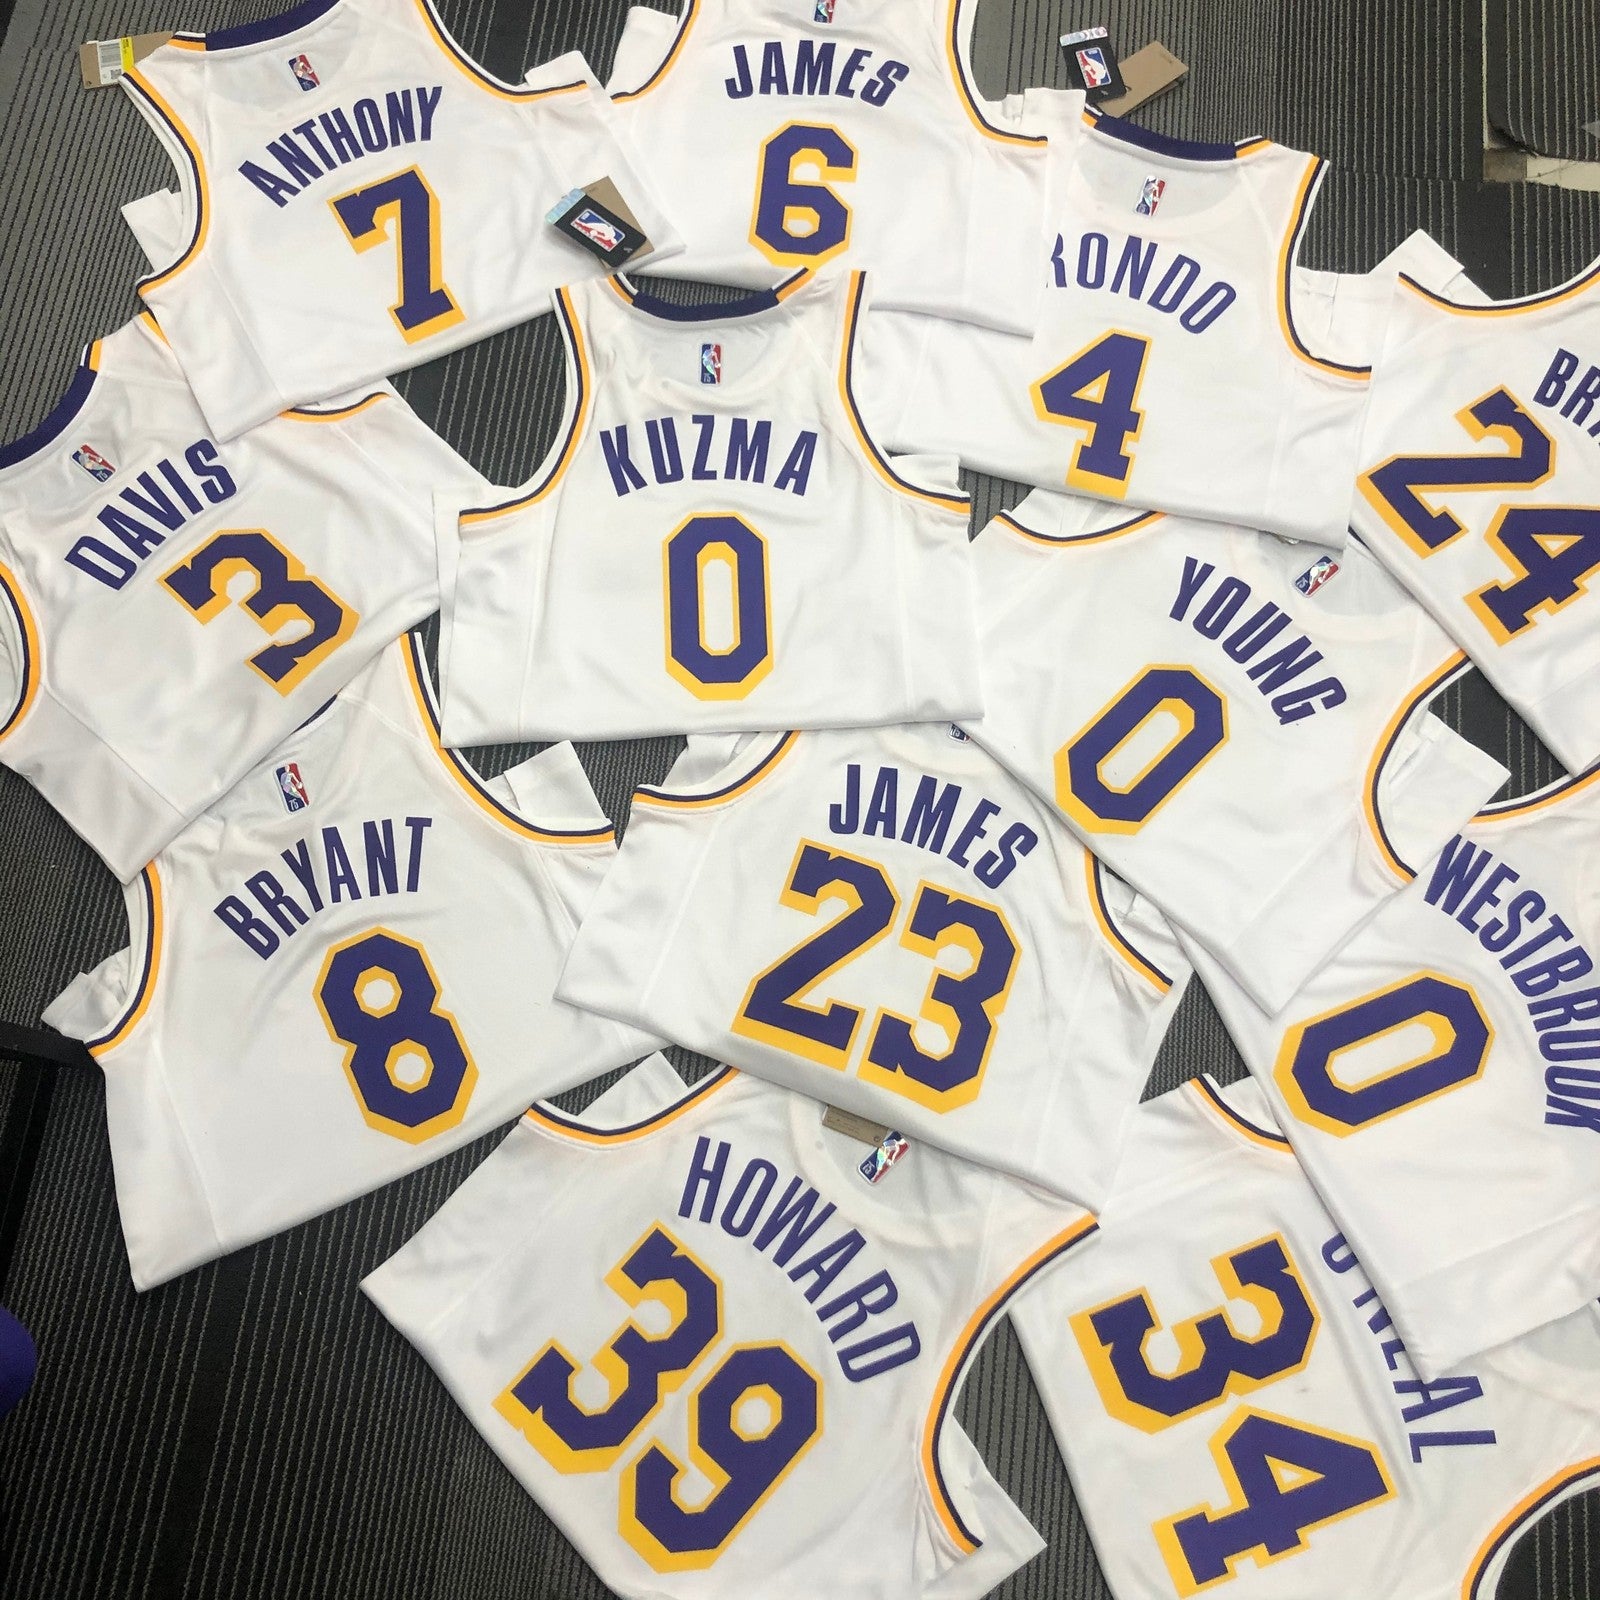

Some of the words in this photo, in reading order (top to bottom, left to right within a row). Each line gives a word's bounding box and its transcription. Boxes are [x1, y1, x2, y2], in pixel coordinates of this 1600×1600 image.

[240, 87, 441, 206] ANTHONY
[727, 40, 908, 105] JAMES
[328, 165, 465, 344] 7
[749, 121, 858, 269] 6
[601, 415, 817, 496] KUZMA
[1029, 330, 1153, 498] 4
[64, 439, 237, 590] DAVIS
[1356, 385, 1600, 648] 24
[158, 529, 359, 696] 3
[662, 512, 775, 701] 0
[1172, 557, 1346, 725] YOUNG
[829, 764, 1038, 889] JAMES
[1054, 664, 1230, 836] 0
[215, 817, 433, 961] BRYANT
[312, 927, 479, 1145] 8
[731, 838, 1021, 1114] 23
[1274, 969, 1496, 1138] 0
[1424, 834, 1600, 1133] WESTBROOK
[679, 1137, 921, 1382] HOWARD
[493, 1220, 824, 1574] 39
[1068, 1233, 1397, 1599] 34
